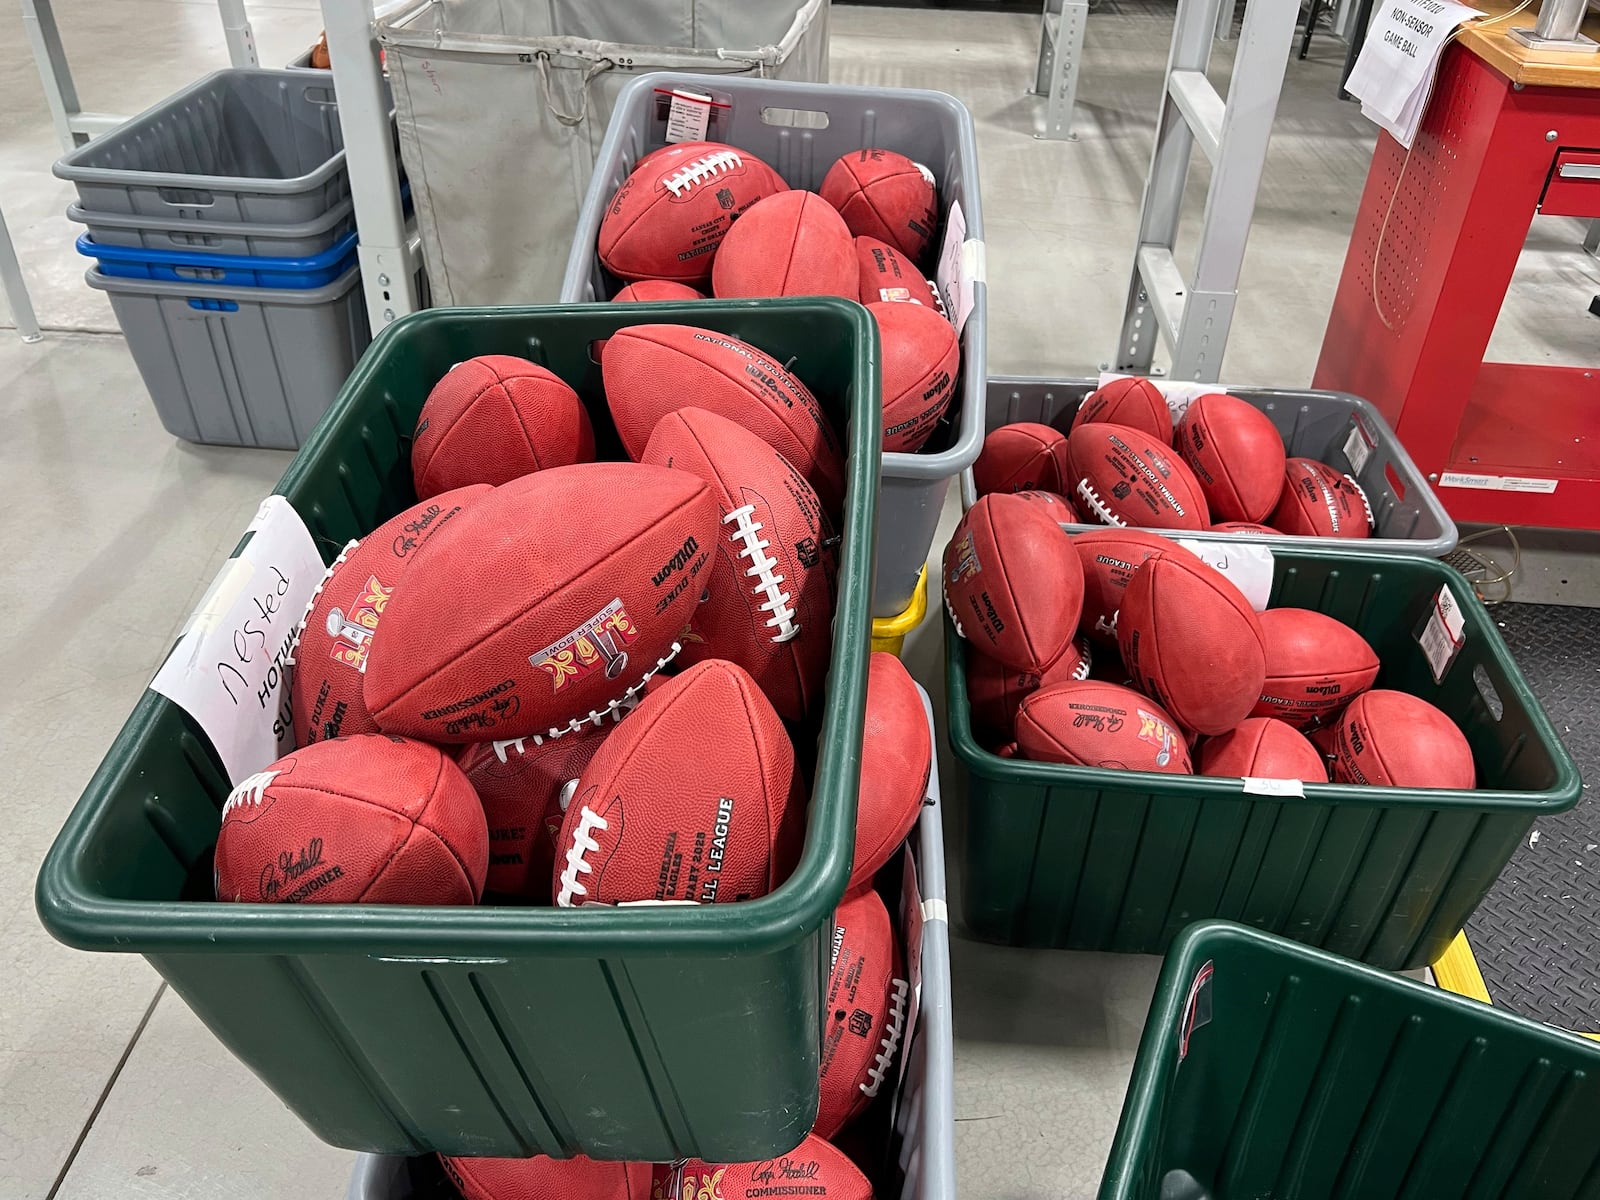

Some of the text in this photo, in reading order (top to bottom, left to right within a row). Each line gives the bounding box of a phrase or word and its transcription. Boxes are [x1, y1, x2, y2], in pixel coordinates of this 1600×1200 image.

[1390, 7, 1434, 38] NON-SENSOR
[1383, 30, 1418, 58] GAME BALL
[694, 333, 753, 360] NATIONAL
[755, 358, 808, 408] FOOTBALL
[744, 363, 794, 410] Wilson
[923, 372, 950, 401] Wilson
[886, 416, 919, 437] LEAGUE
[1129, 452, 1160, 484] FOOTBALL
[1158, 482, 1186, 518] NATIONAL
[1301, 477, 1318, 503] Wilson
[651, 535, 699, 587] Wilson
[1095, 554, 1132, 571] LEAGUE
[980, 591, 1005, 634] Wilson
[217, 566, 290, 705] nested
[543, 606, 614, 658] SUPER BOWL
[420, 678, 516, 721] COMMISSIONER
[1305, 684, 1341, 696] Wilson
[1350, 720, 1364, 757] Wilson
[707, 796, 733, 872] LEAGUE
[654, 831, 677, 900] ILADELPHIA
[666, 852, 682, 896] EAGLES
[745, 1186, 827, 1198] COMMISSIONER
